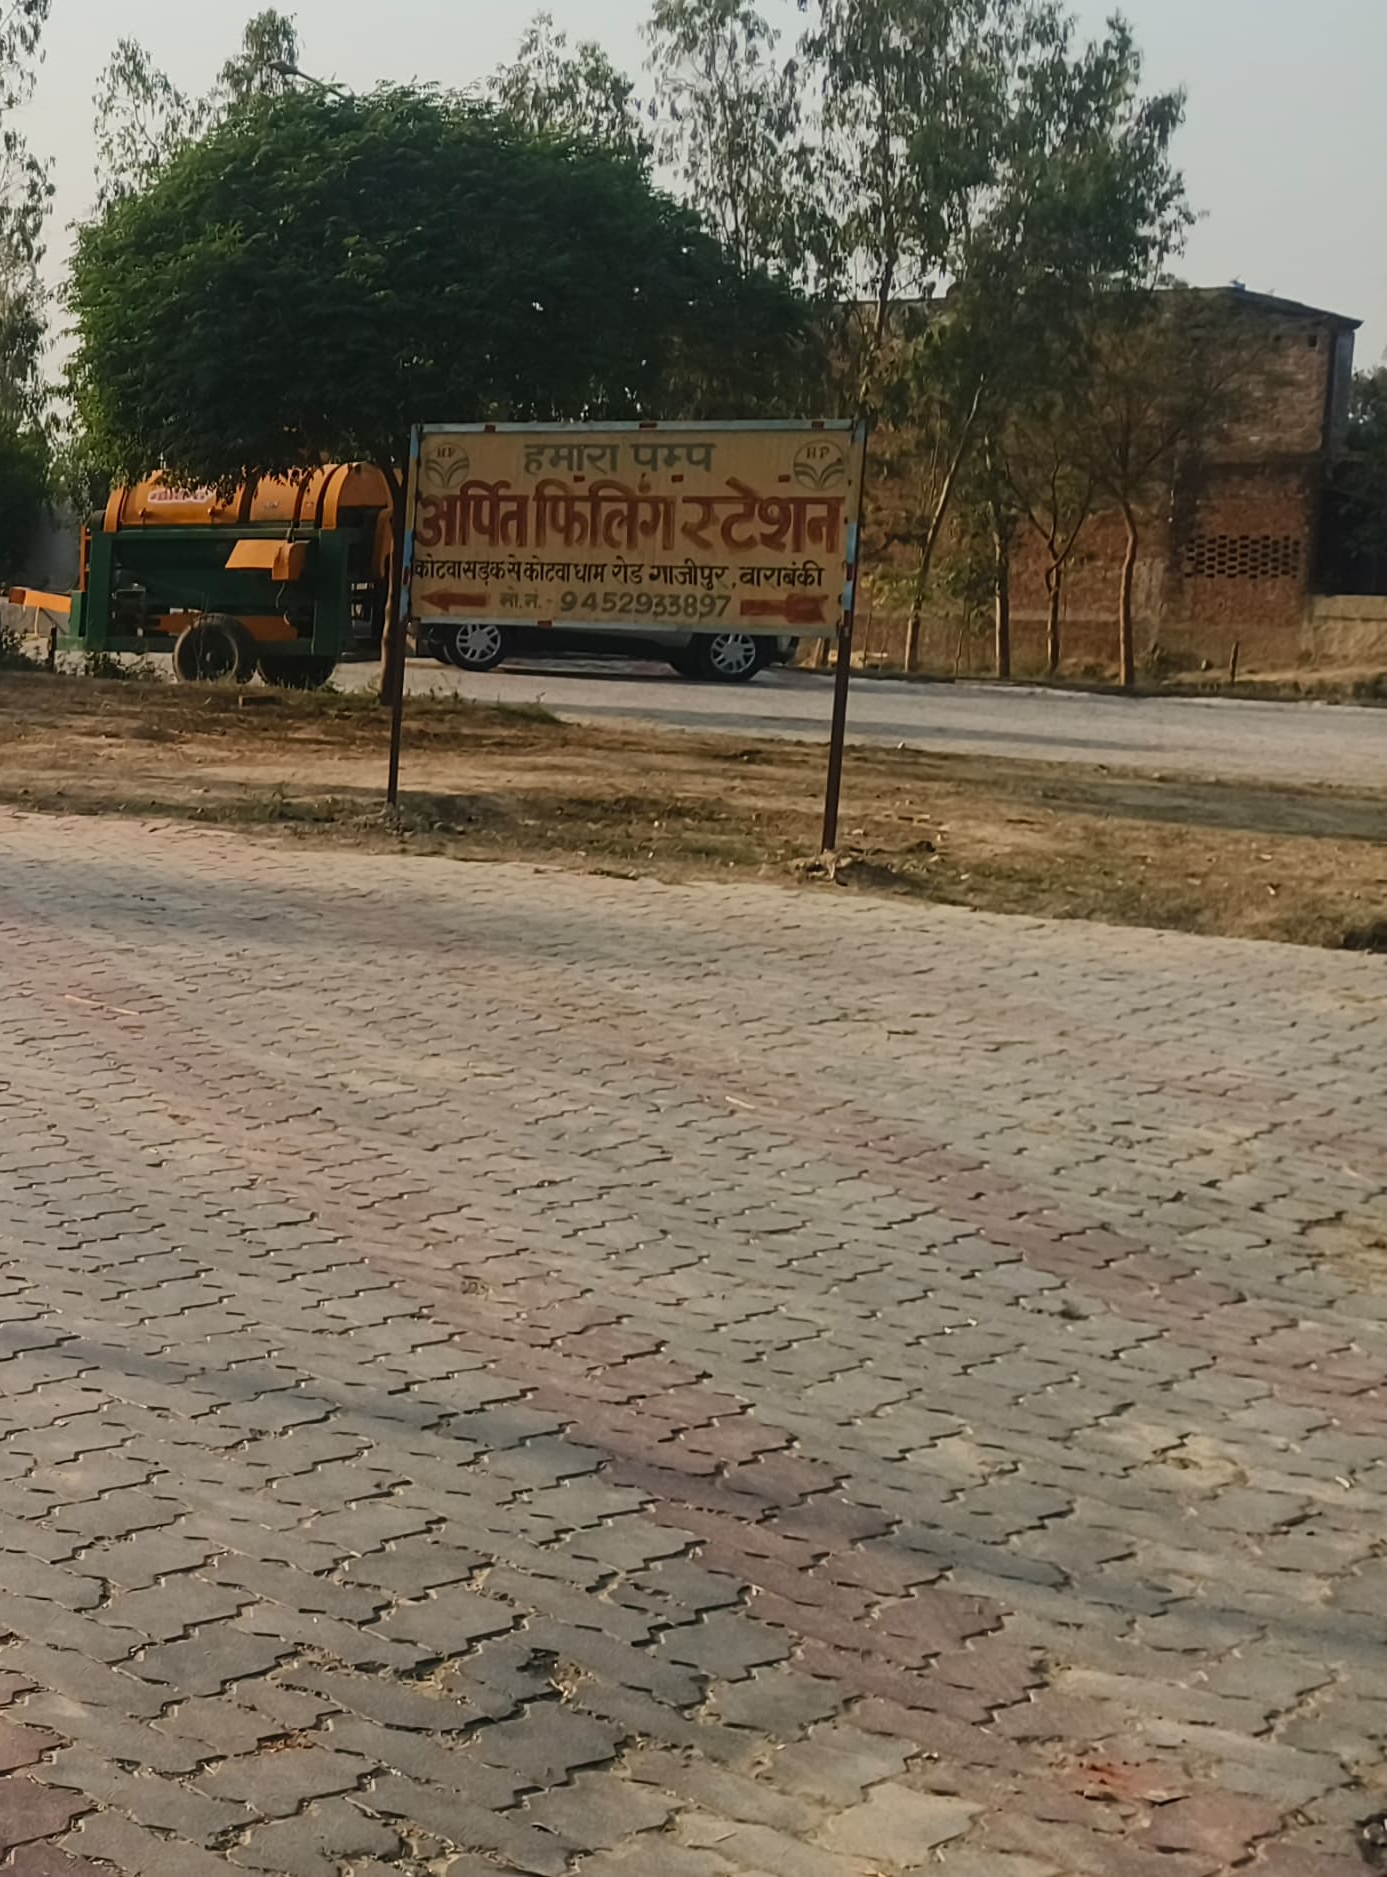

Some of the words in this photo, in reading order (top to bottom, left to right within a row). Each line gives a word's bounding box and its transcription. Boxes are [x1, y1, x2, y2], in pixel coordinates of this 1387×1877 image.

[523, 443, 620, 476] हमारा
[629, 443, 717, 472] पम्प
[805, 446, 830, 459] HP
[415, 479, 530, 548] अर्पित
[532, 475, 676, 551] फिलिंग
[612, 555, 645, 585] रोड
[559, 590, 732, 619] 9452933897
